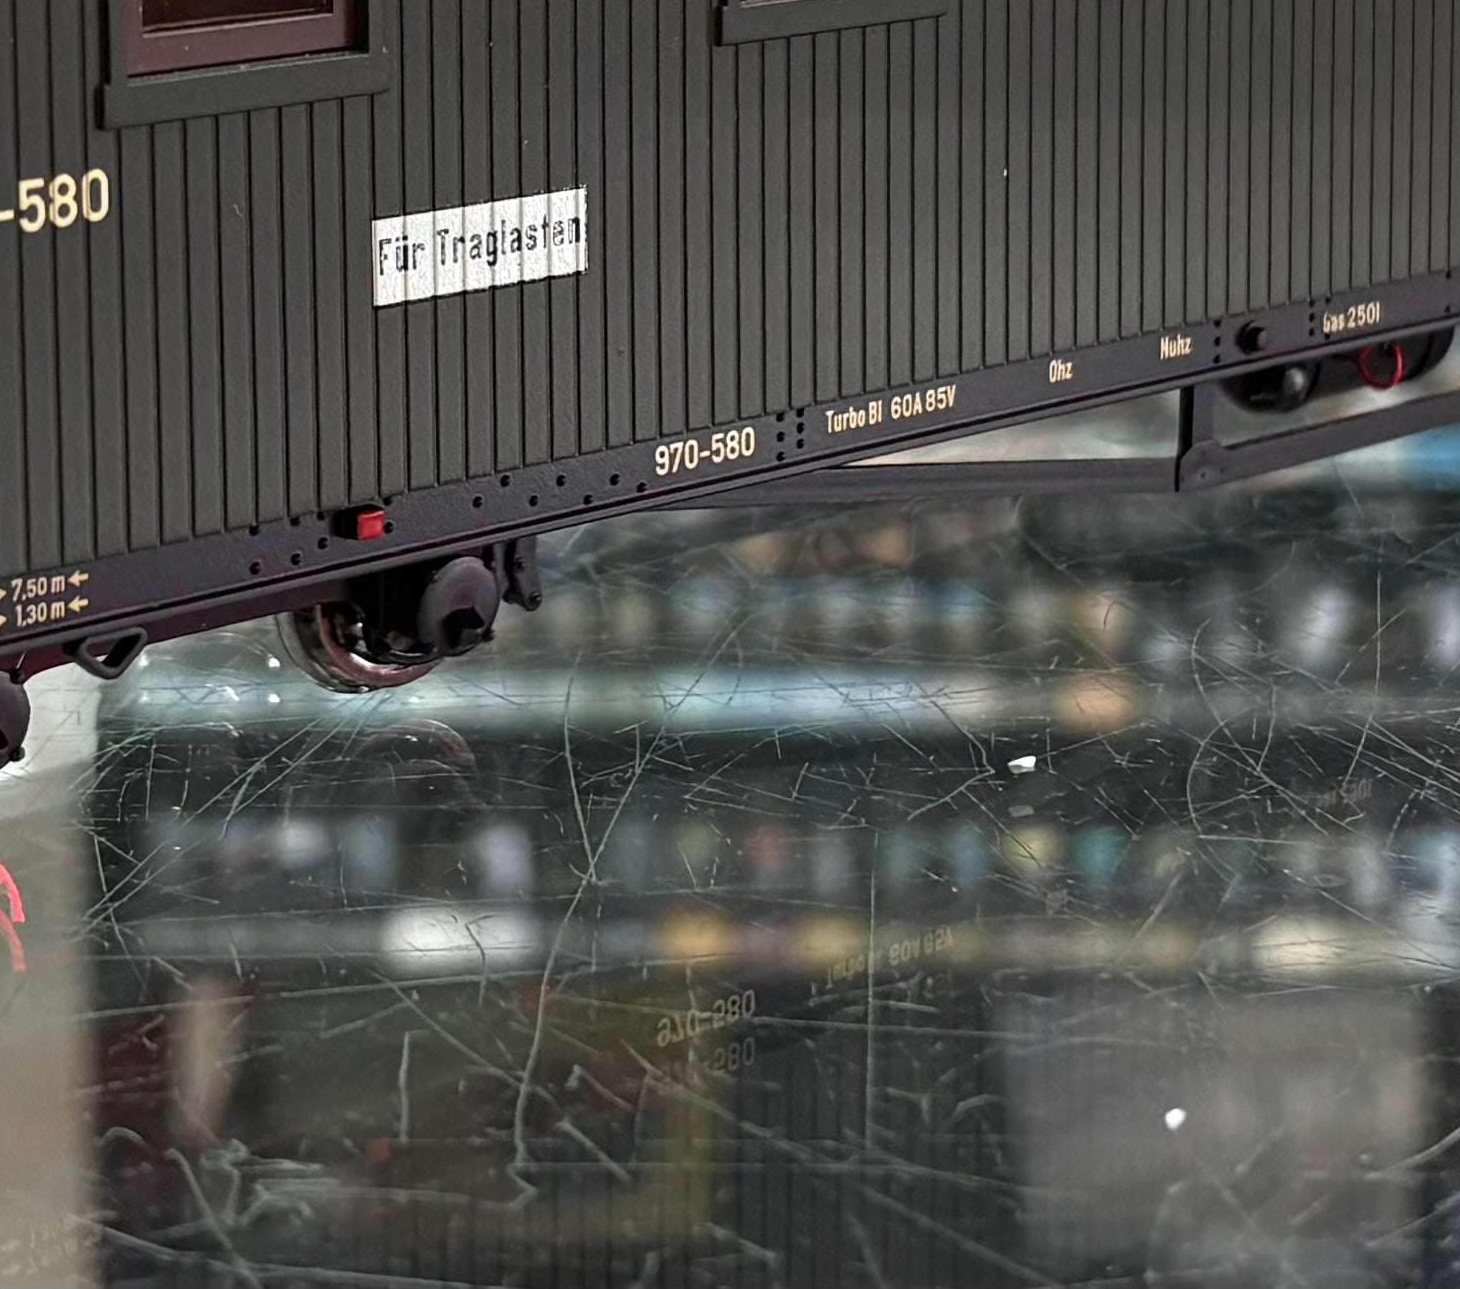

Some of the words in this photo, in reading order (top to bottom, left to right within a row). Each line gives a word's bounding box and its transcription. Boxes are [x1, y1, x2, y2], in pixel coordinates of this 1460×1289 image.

[378, 234, 426, 276] Für
[436, 213, 581, 267] Traglasten
[825, 405, 866, 434] Turbo
[890, 391, 923, 420] 60A
[925, 383, 957, 412] 85V
[654, 425, 756, 477] 970-580
[50, 574, 66, 594] m
[50, 600, 66, 620] m
